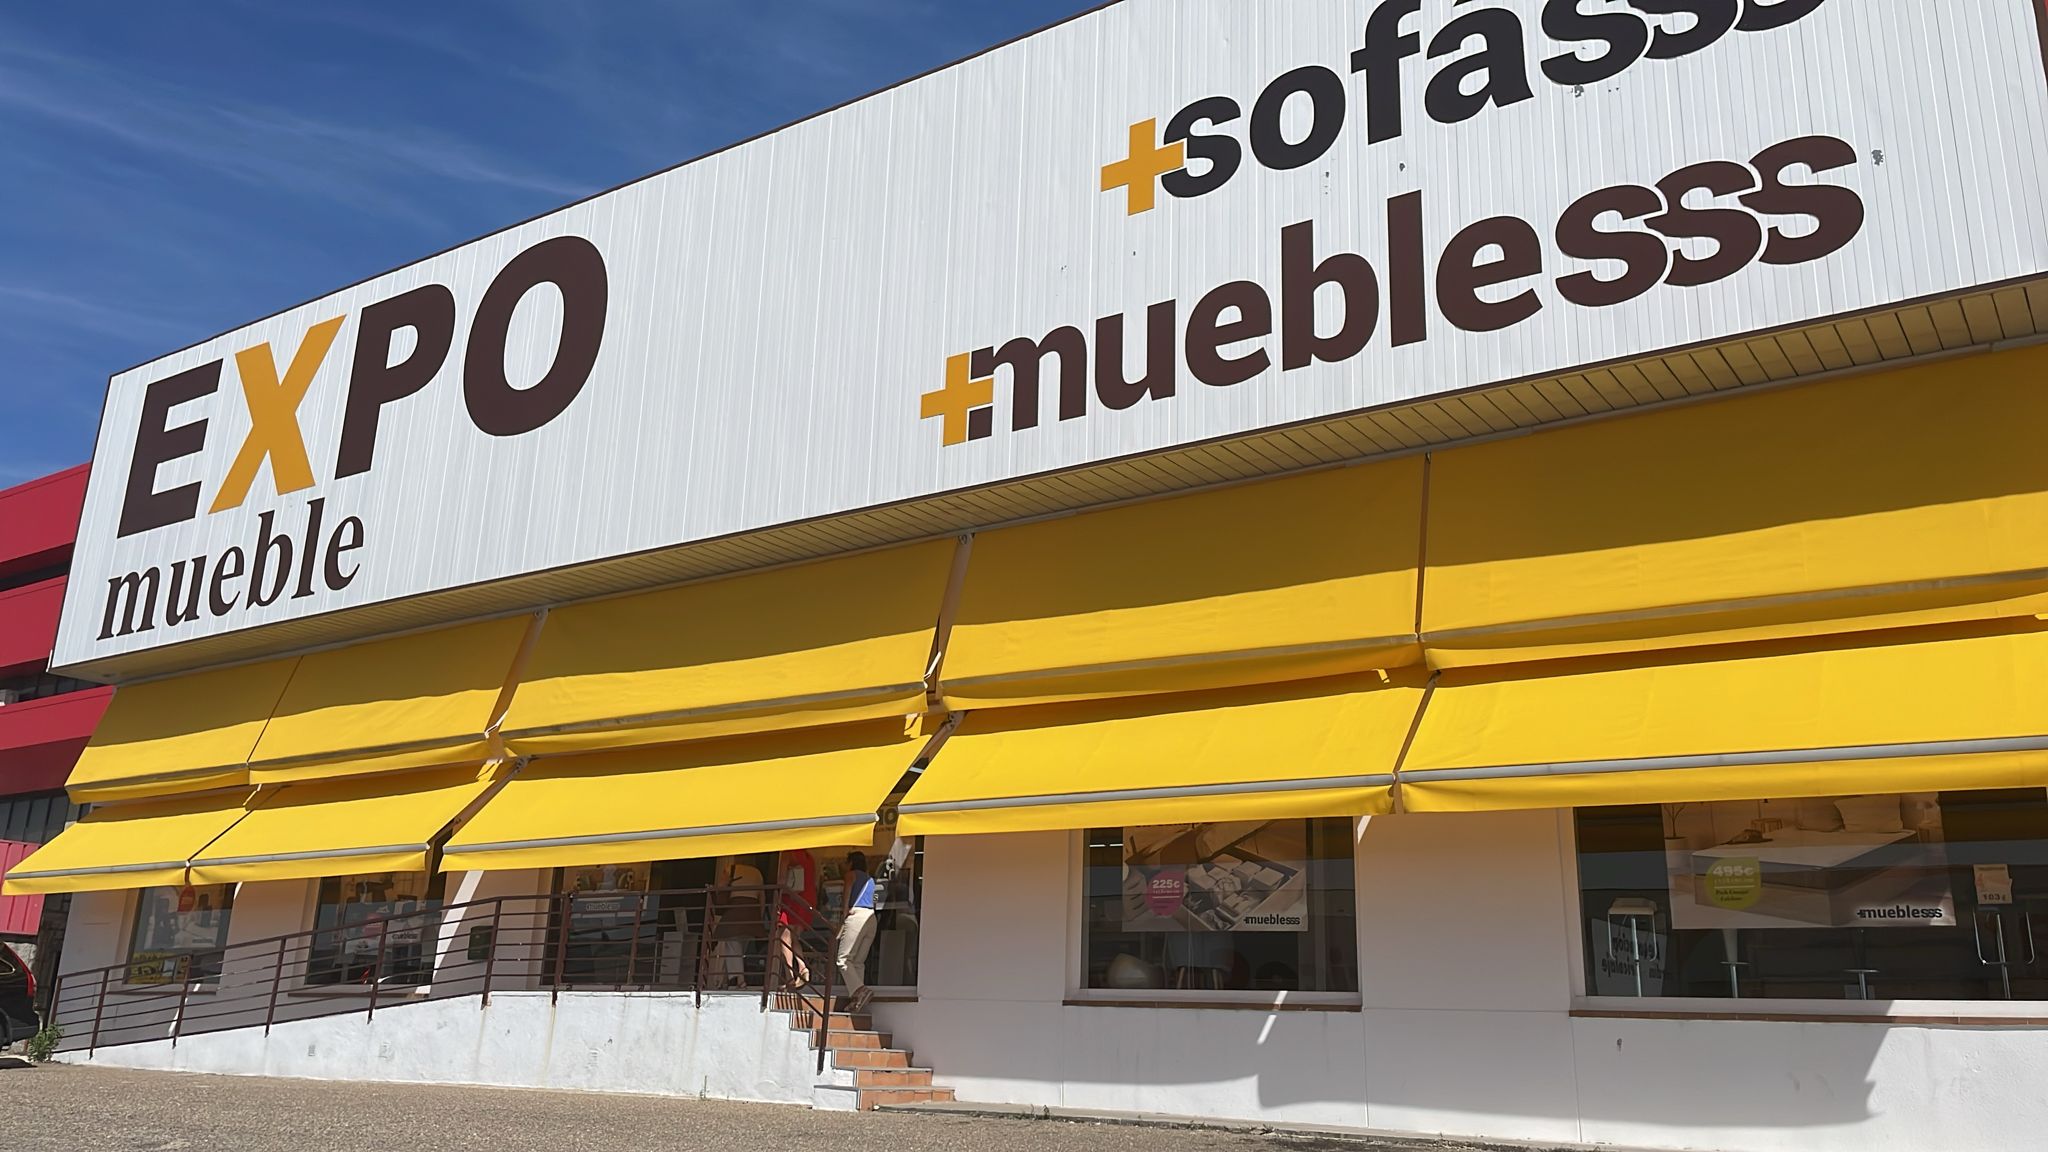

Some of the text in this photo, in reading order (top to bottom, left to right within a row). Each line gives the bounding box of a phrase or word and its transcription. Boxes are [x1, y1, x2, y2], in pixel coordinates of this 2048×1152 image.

[1100, 0, 1827, 216] +sofás
[116, 235, 608, 538] EXPO
[96, 497, 365, 641] mueble
